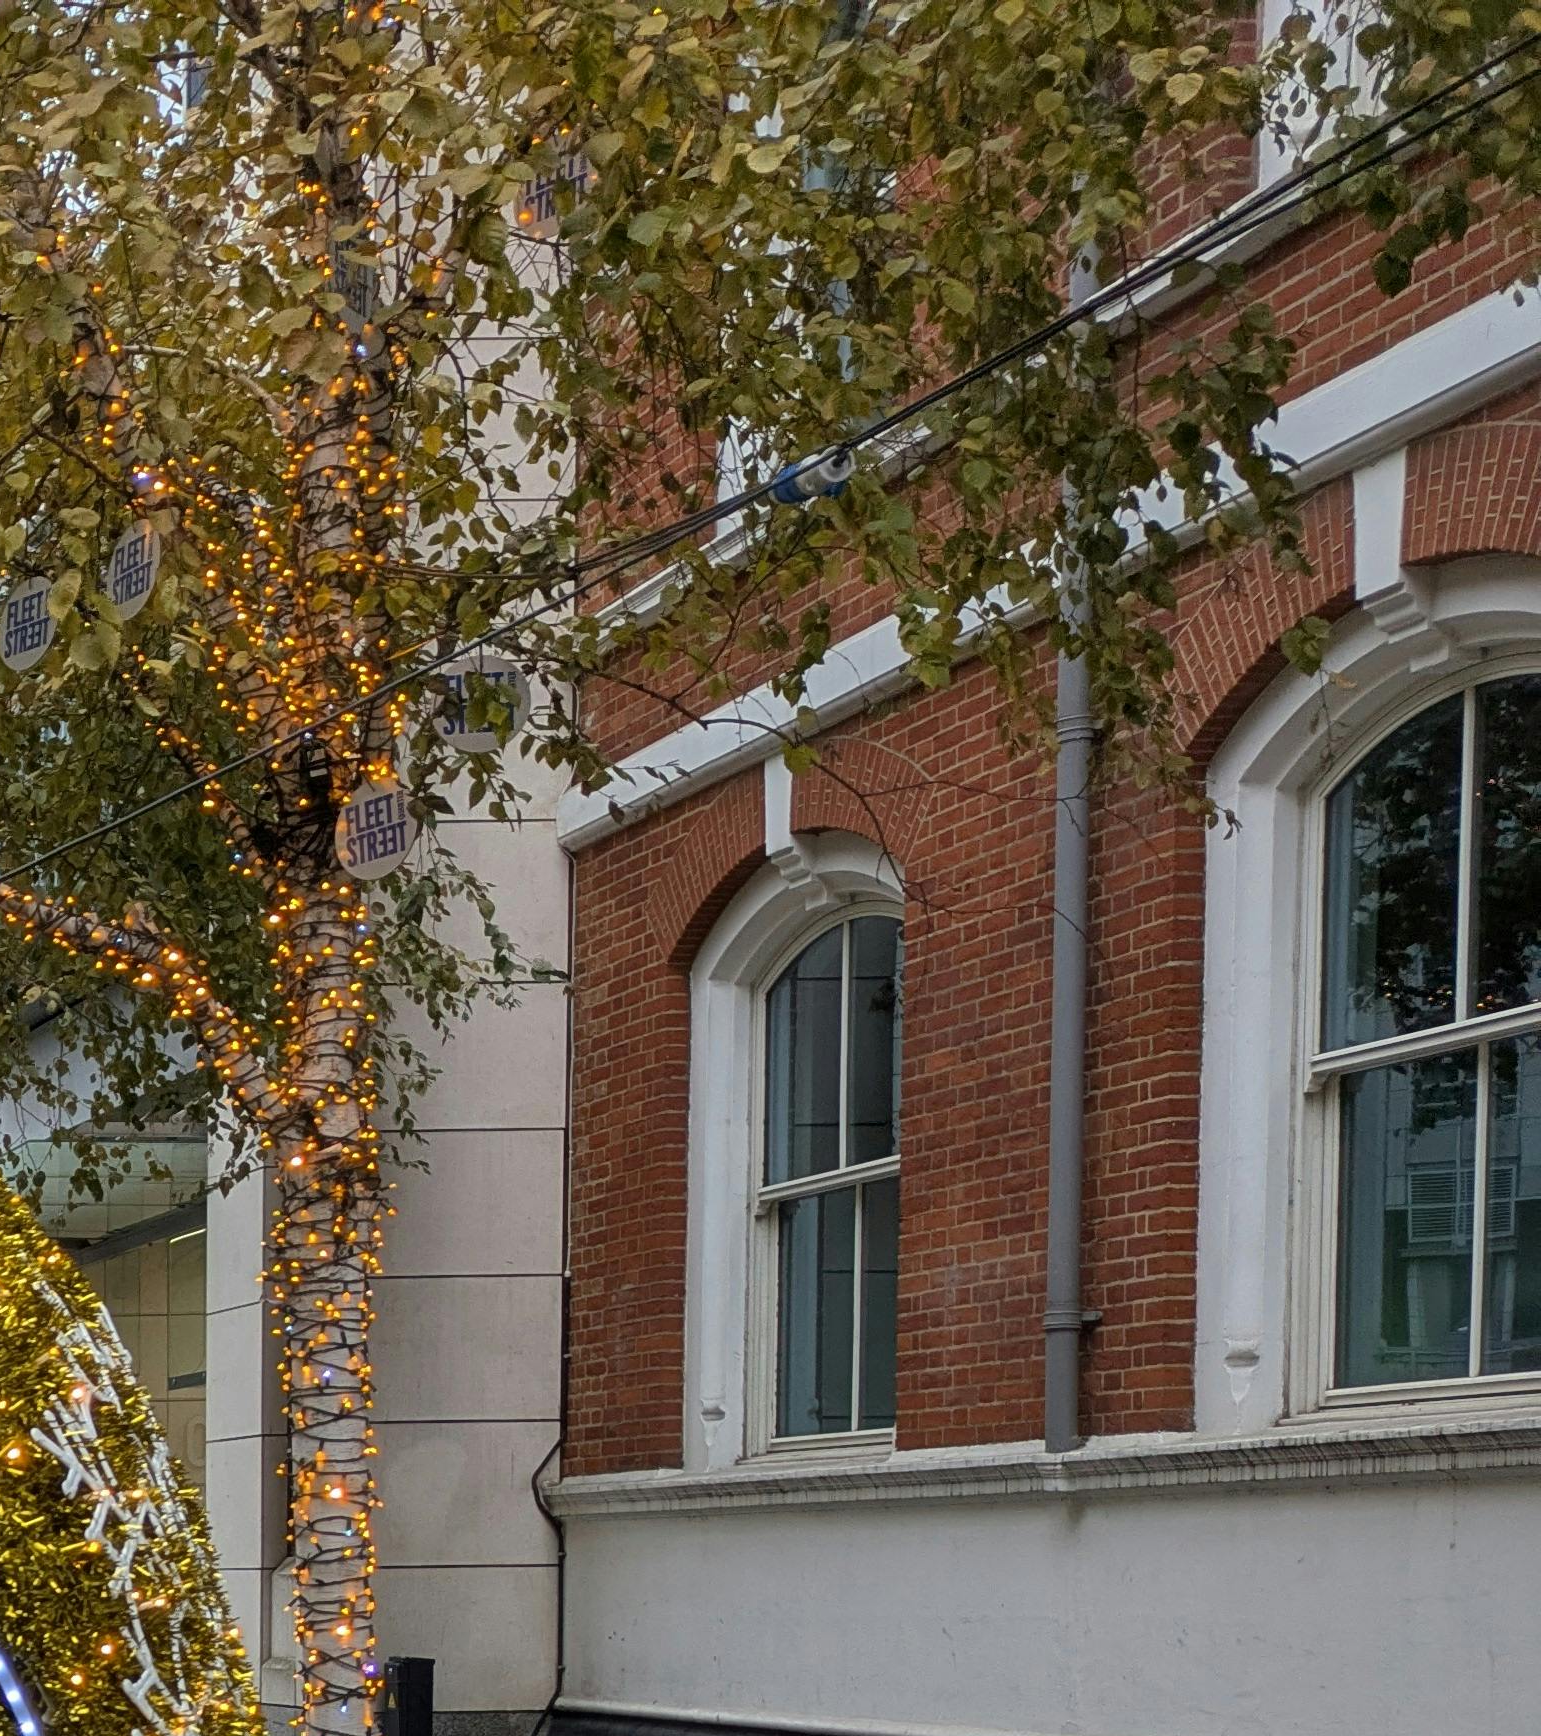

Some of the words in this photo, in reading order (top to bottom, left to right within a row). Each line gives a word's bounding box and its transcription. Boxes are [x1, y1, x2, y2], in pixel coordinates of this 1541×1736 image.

[114, 535, 147, 577] FLEET
[6, 591, 44, 631] FLEET
[345, 793, 394, 836] FLEET
